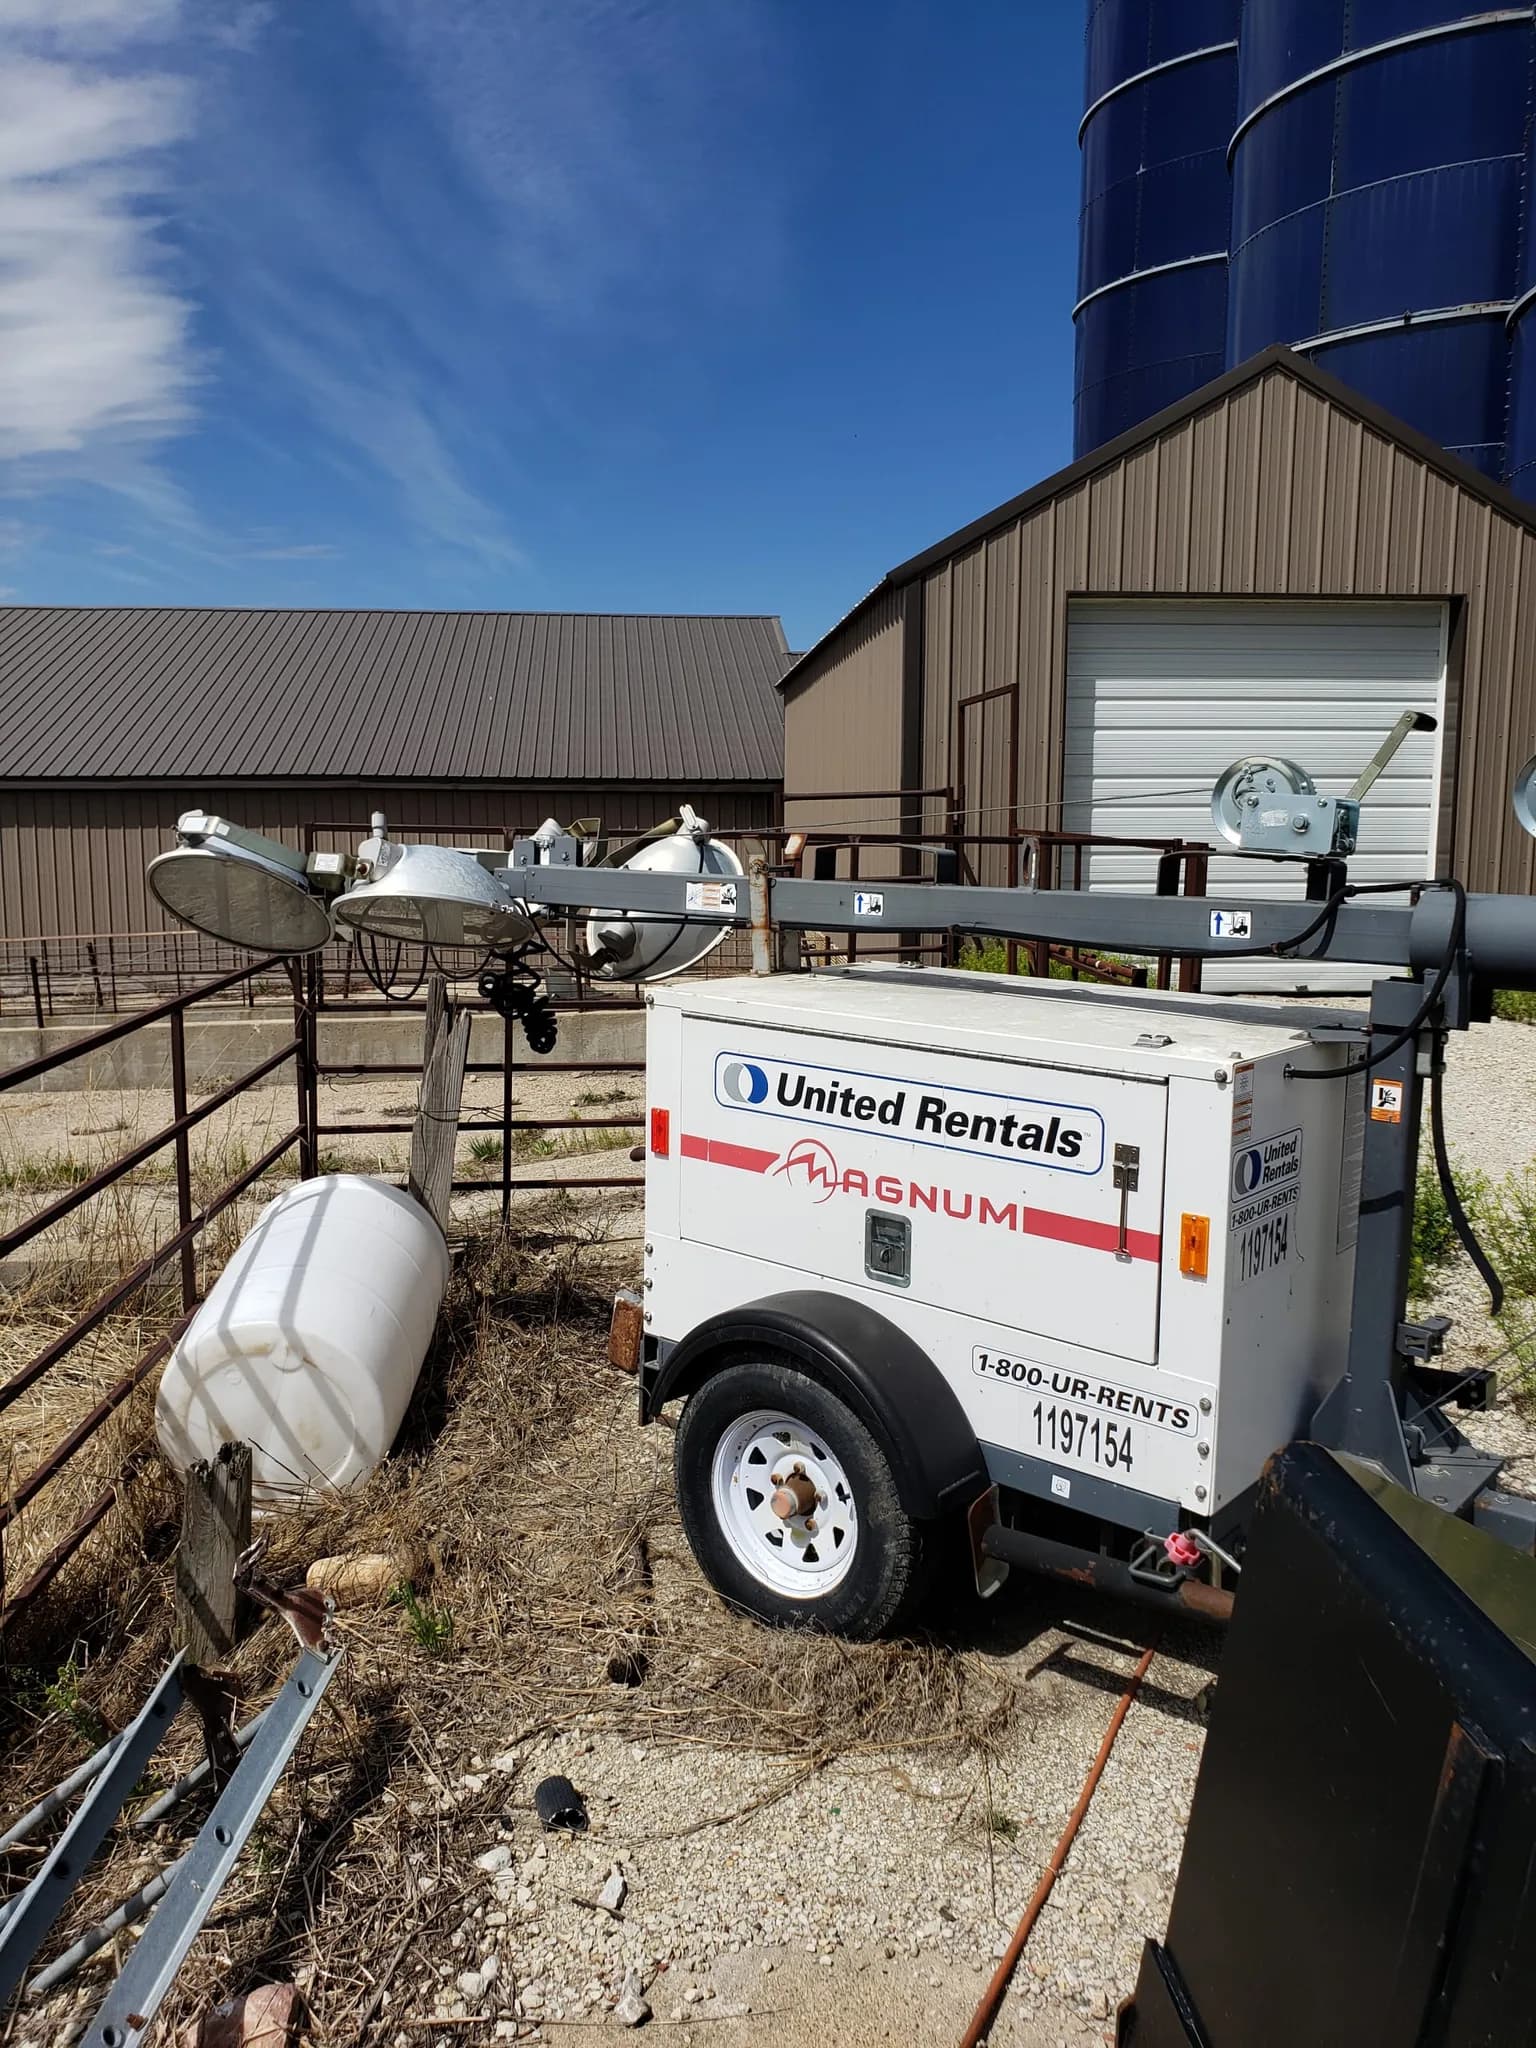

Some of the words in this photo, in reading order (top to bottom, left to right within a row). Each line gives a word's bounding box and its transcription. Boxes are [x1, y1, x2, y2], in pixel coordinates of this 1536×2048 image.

[776, 1072, 906, 1127] United
[915, 1095, 1083, 1158] Rentals
[1264, 1135, 1297, 1164] United
[772, 1140, 1018, 1232] MAGNUM
[1262, 1157, 1299, 1185] Rentals
[1231, 1185, 1299, 1228] 1-800-UR-RENTS
[1240, 1213, 1288, 1282] 1197154
[978, 1353, 1191, 1429] 1-800-UR-RENTS
[1033, 1401, 1133, 1473] 1197154
